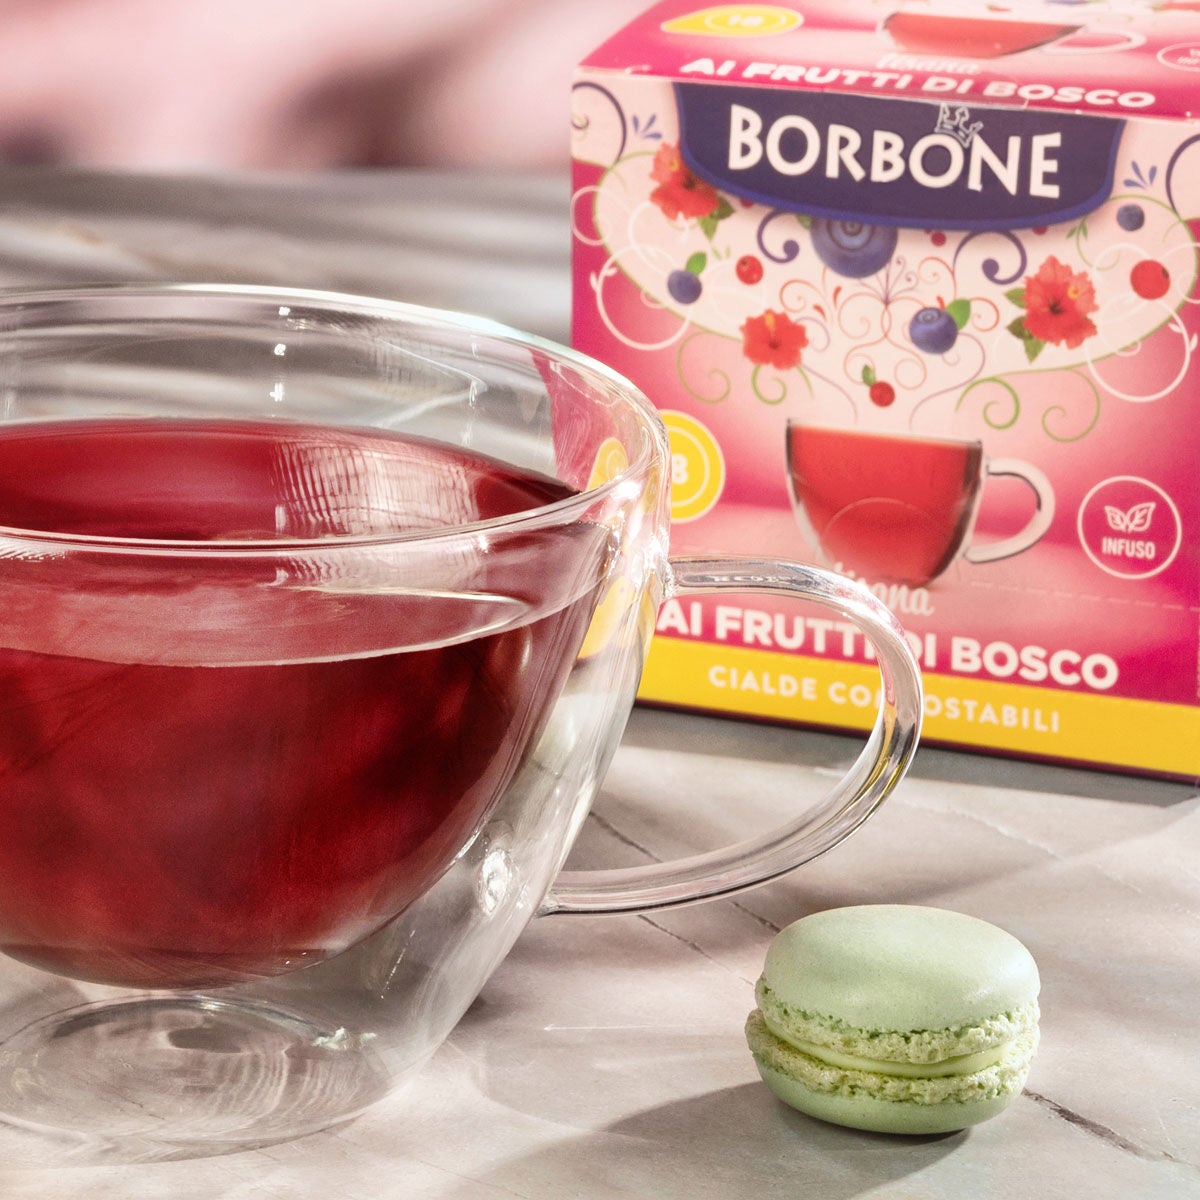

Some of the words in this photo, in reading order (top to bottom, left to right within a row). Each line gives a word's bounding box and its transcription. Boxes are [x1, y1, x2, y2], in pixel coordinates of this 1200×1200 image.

[679, 58, 737, 76] AI
[741, 62, 913, 90] FRUTTI
[921, 75, 974, 95] DI
[983, 81, 1156, 108] BOSCO
[728, 104, 1062, 199] BORBONE
[671, 453, 689, 485] 8
[1102, 537, 1156, 560] INFUSO
[656, 599, 703, 636] AI
[951, 636, 1119, 690] BOSCO
[708, 665, 817, 699] CIALDE
[828, 681, 1060, 733] COOSTABILI
